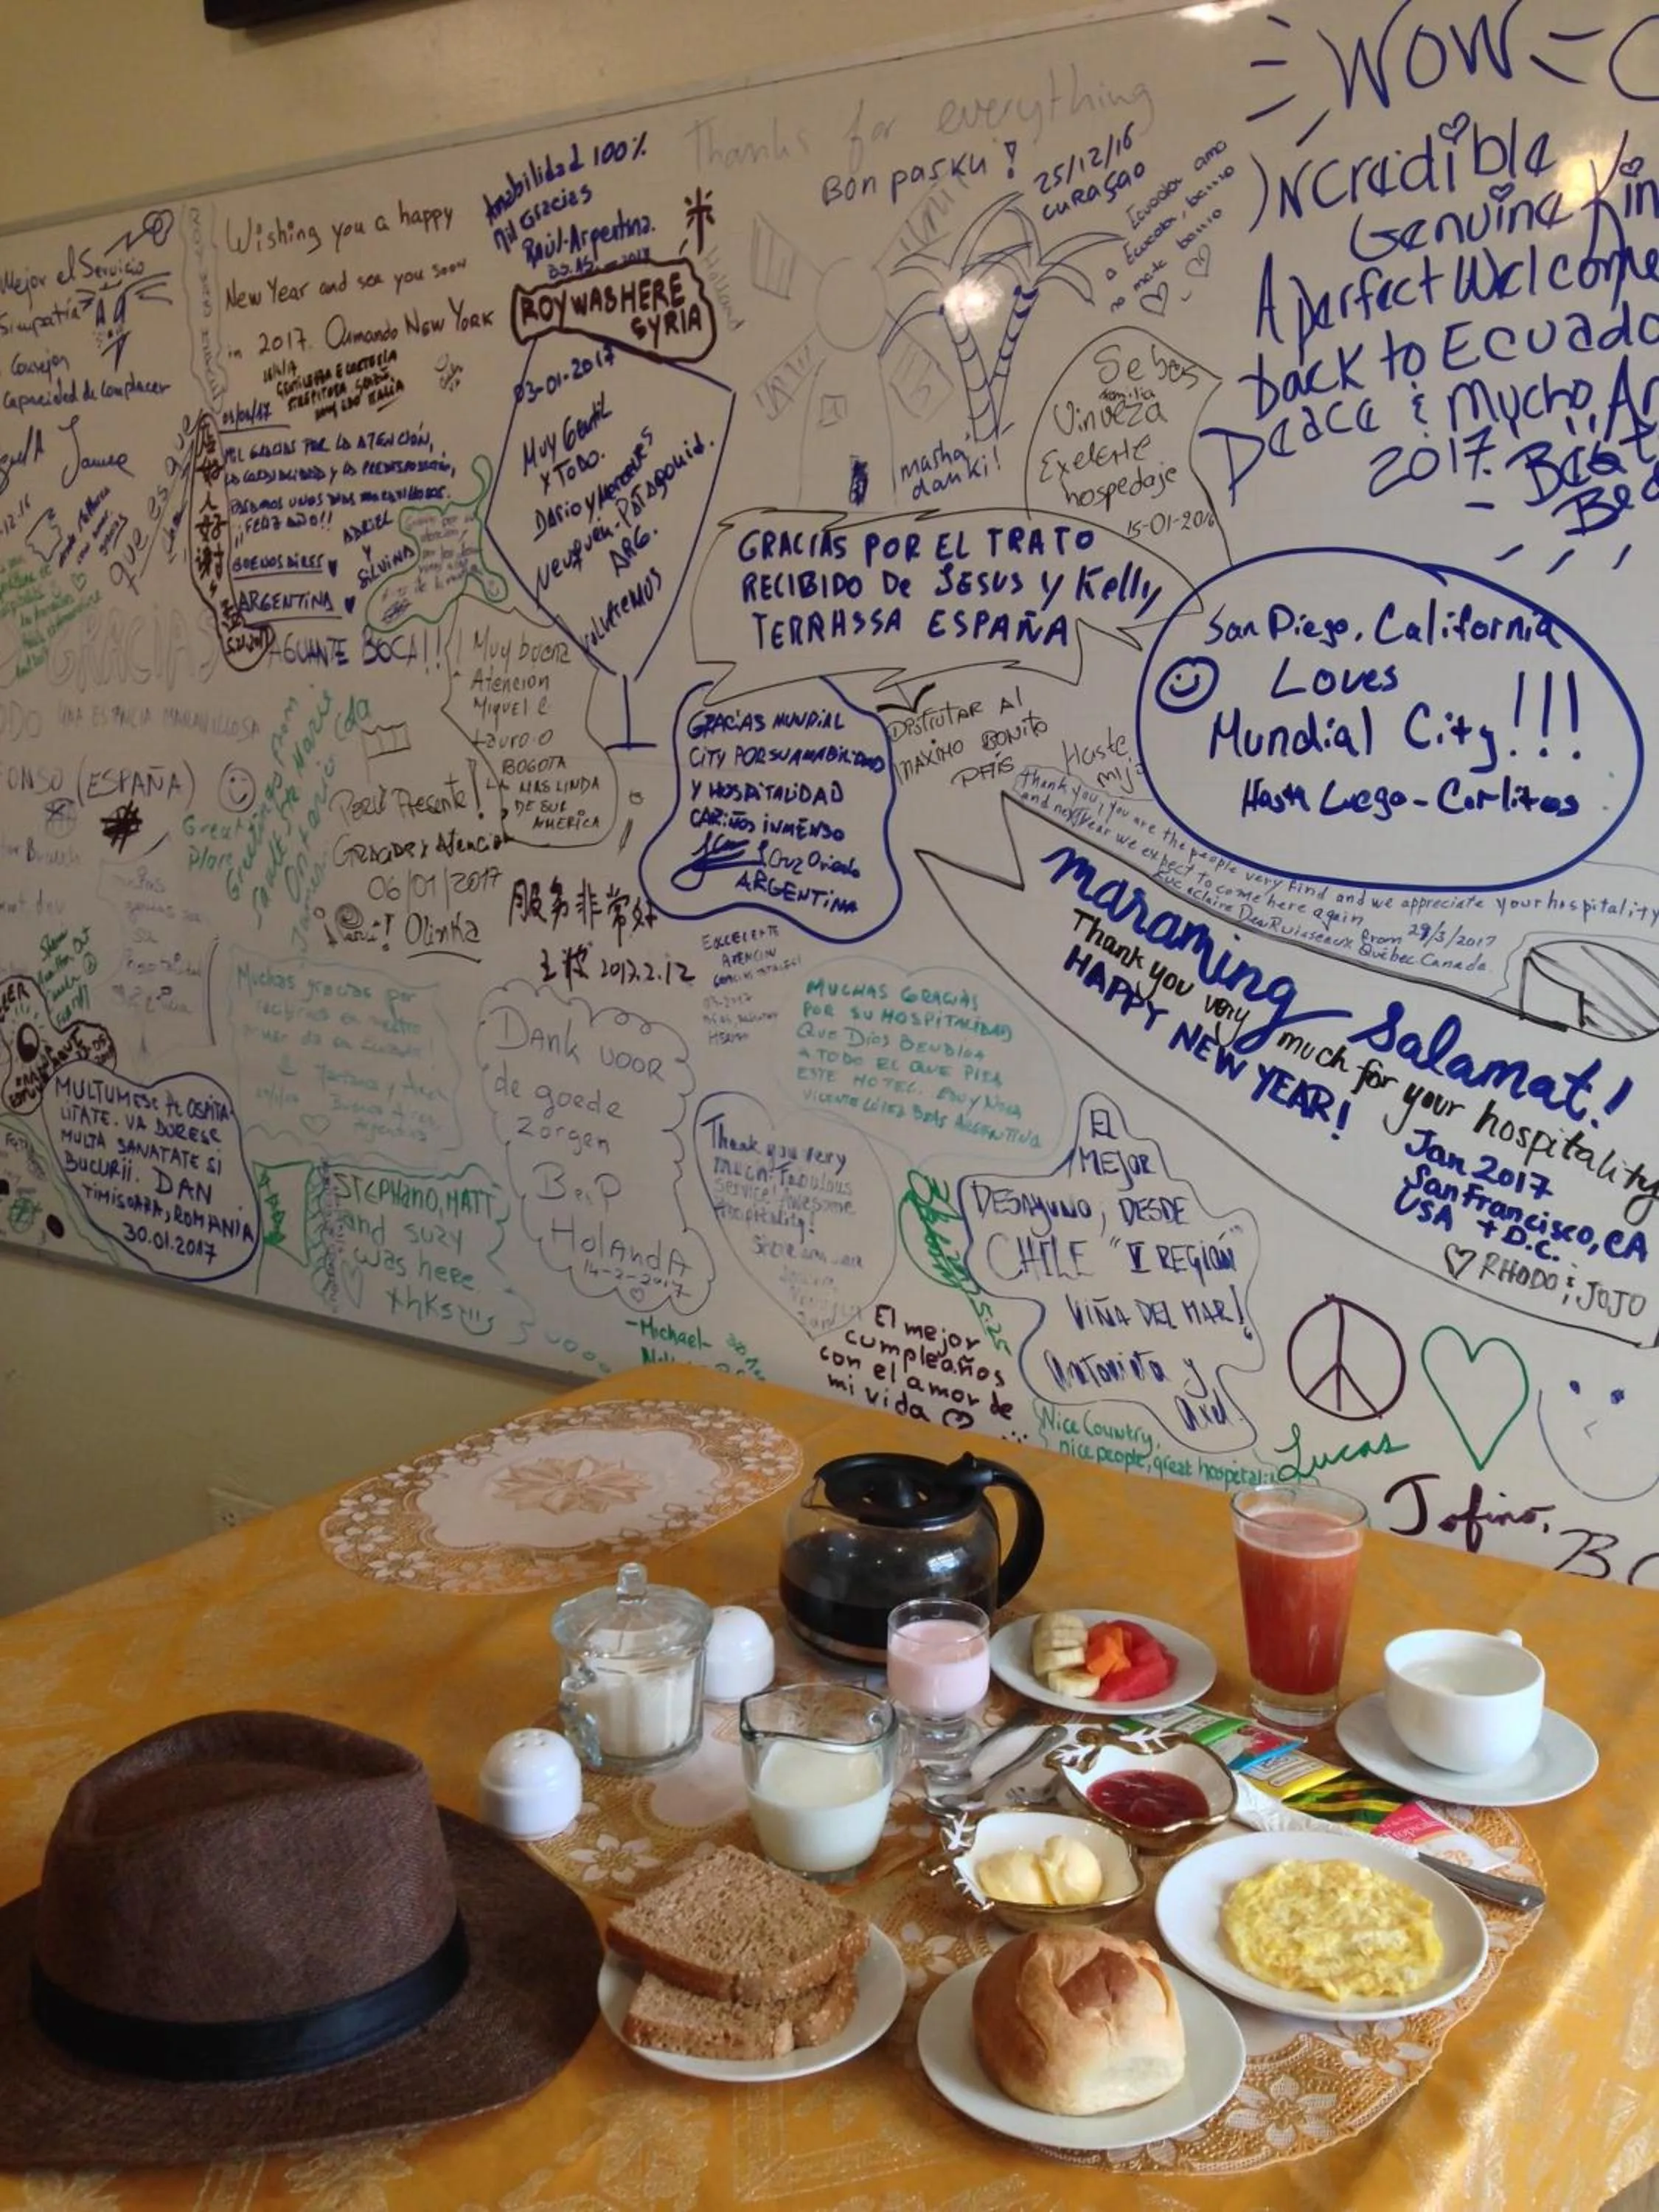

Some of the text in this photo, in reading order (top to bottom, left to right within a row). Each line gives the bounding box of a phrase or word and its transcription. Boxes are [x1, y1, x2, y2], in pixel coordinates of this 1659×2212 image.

[1317, 0, 1521, 109] WOW
[592, 131, 647, 167] 100%
[1034, 121, 1135, 195] 25/12/16
[226, 217, 321, 254] Wishing
[332, 221, 365, 253] you
[398, 199, 453, 232] happy
[226, 279, 261, 310] New
[267, 276, 310, 304] Year
[319, 271, 347, 293] and
[394, 270, 423, 294] you
[521, 289, 568, 328] ROY
[620, 272, 686, 313] HERE
[631, 303, 702, 349] SYRIA
[1381, 330, 1425, 380] to
[738, 526, 1095, 567] GRACIAS POR EL TRATO
[742, 571, 863, 603] RECIBIDO
[752, 607, 1069, 651] TERRASSA ESPAÑA
[1205, 604, 1256, 646] San
[1375, 598, 1562, 649] California
[1270, 657, 1399, 698] Loves
[1209, 705, 1373, 759] Mundial
[556, 776, 600, 794] LINDA
[1161, 823, 1185, 852] the
[1189, 847, 1237, 874] people
[1245, 871, 1283, 897] very
[1336, 890, 1366, 906] and
[1371, 897, 1393, 909] we
[1400, 894, 1483, 917] appreciate
[1497, 897, 1542, 918] your
[1267, 892, 1306, 914] here
[1062, 945, 1169, 1031] HAPPY
[1168, 1021, 1248, 1082] NEW
[1073, 908, 1144, 970] Thank
[1136, 961, 1195, 1001] you
[1205, 994, 1252, 1046] very
[1276, 1031, 1349, 1073] much
[1351, 1057, 1399, 1095] for
[1382, 1082, 1466, 1135] your
[494, 1060, 624, 1119] de goede
[152, 1166, 212, 1205] DAN
[1402, 1164, 1459, 1203] San
[1405, 1128, 1554, 1200] Jan 2017
[1119, 1195, 1190, 1226] DESDE
[1394, 1182, 1454, 1231] USA
[1134, 1298, 1178, 1329] DEL
[845, 1329, 1005, 1388] cumpleaños
[905, 1324, 981, 1358] mejor
[819, 1345, 1013, 1420] con el amor de
[828, 1373, 931, 1423] mi vida
[1042, 1404, 1079, 1433] Nice
[1059, 1437, 1096, 1459] nice
[1274, 1423, 1410, 1481] Lucas
